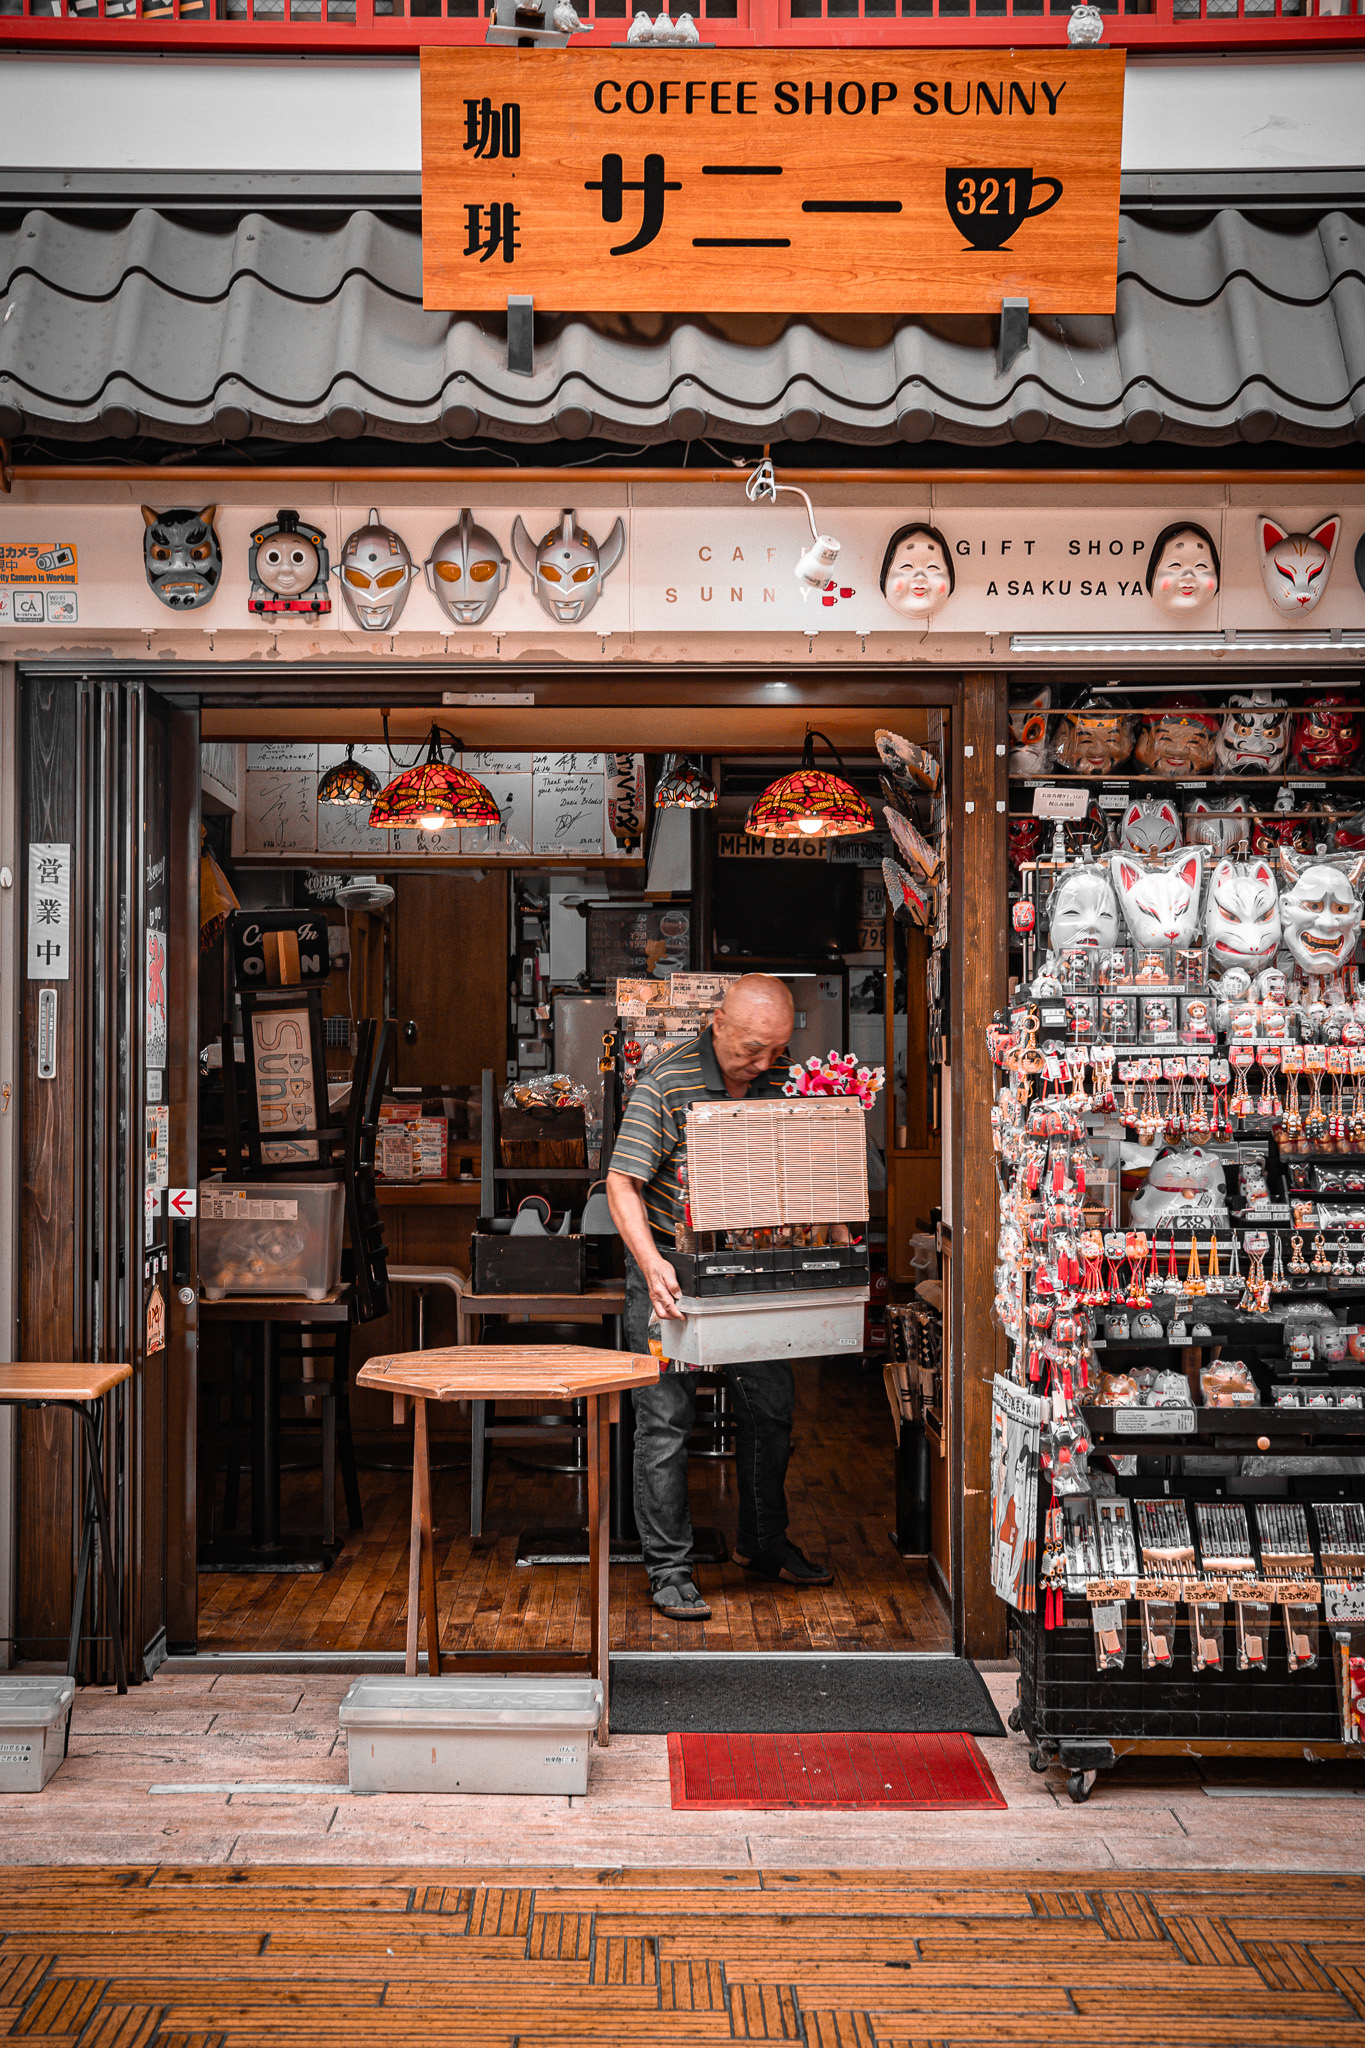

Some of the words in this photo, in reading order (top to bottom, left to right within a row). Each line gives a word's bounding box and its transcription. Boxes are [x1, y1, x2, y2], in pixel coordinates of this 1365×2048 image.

[594, 80, 757, 115] COFFEE
[774, 81, 898, 115] SHOP
[913, 81, 1067, 116] SUNNY
[462, 97, 521, 264] 珈琲
[584, 152, 903, 257] サニー
[956, 177, 1018, 217] 321
[956, 539, 1036, 557] GIFT
[1068, 539, 1145, 557] SHOP
[11, 573, 37, 582] Camera
[46, 573, 75, 583] Working
[986, 579, 1144, 597] ASAKUSAYA
[720, 836, 766, 855] MHM
[36, 857, 63, 966] 営業中
[297, 923, 319, 941] In
